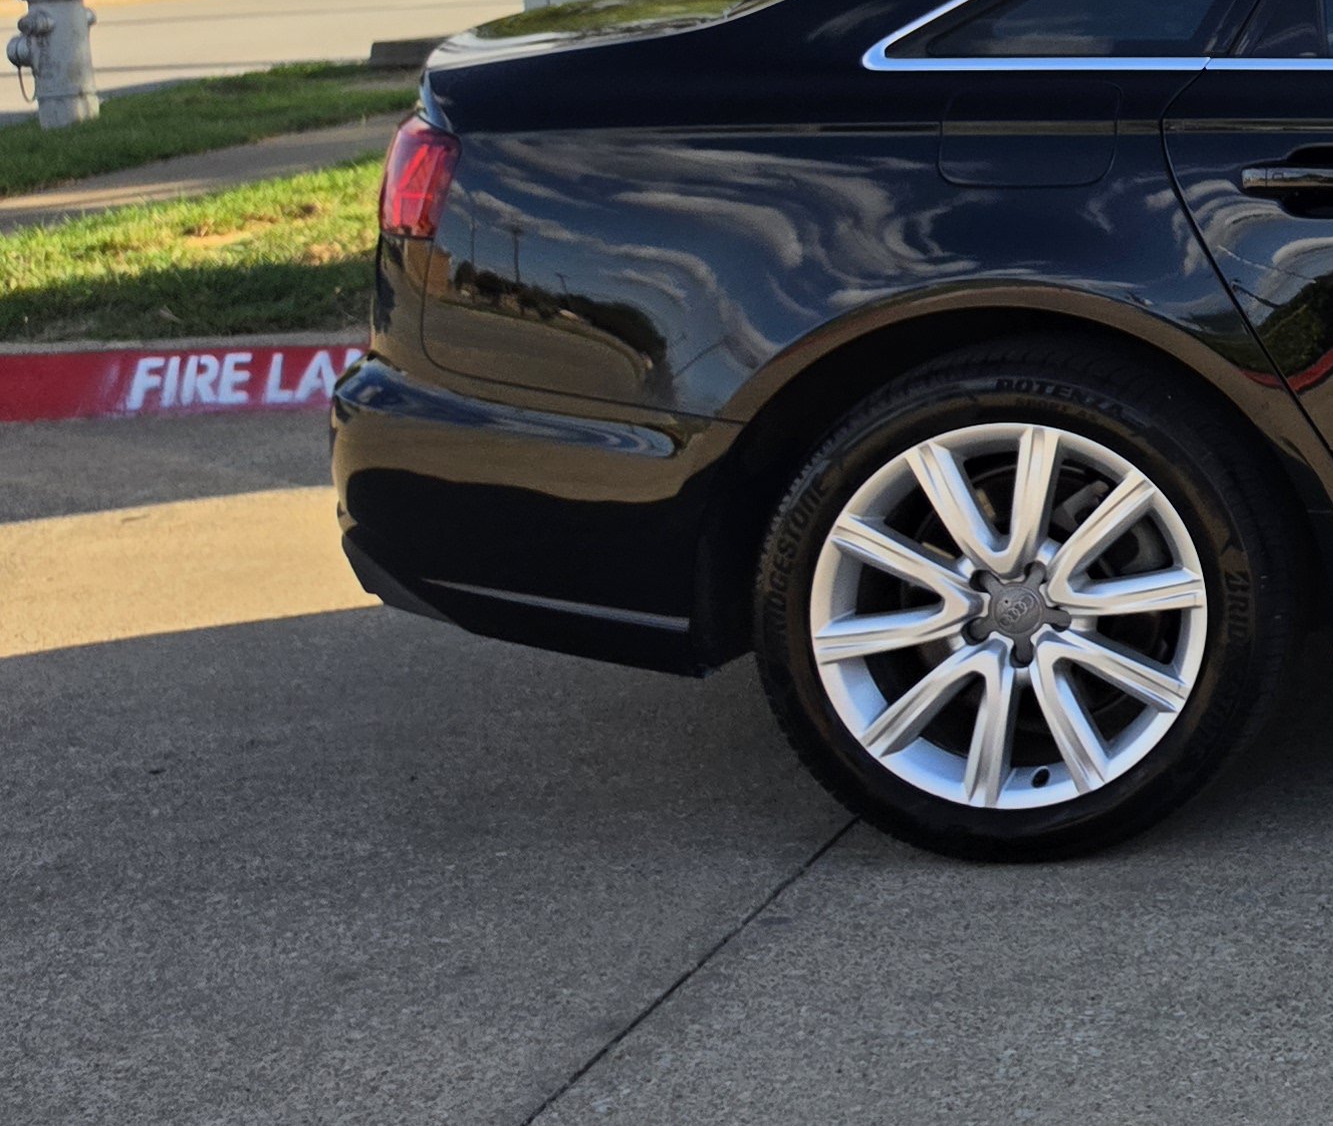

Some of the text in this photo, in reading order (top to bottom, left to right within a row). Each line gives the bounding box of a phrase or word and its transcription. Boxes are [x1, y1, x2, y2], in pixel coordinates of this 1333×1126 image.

[126, 347, 366, 410] FIRE LA
[995, 377, 1126, 415] POTENZA
